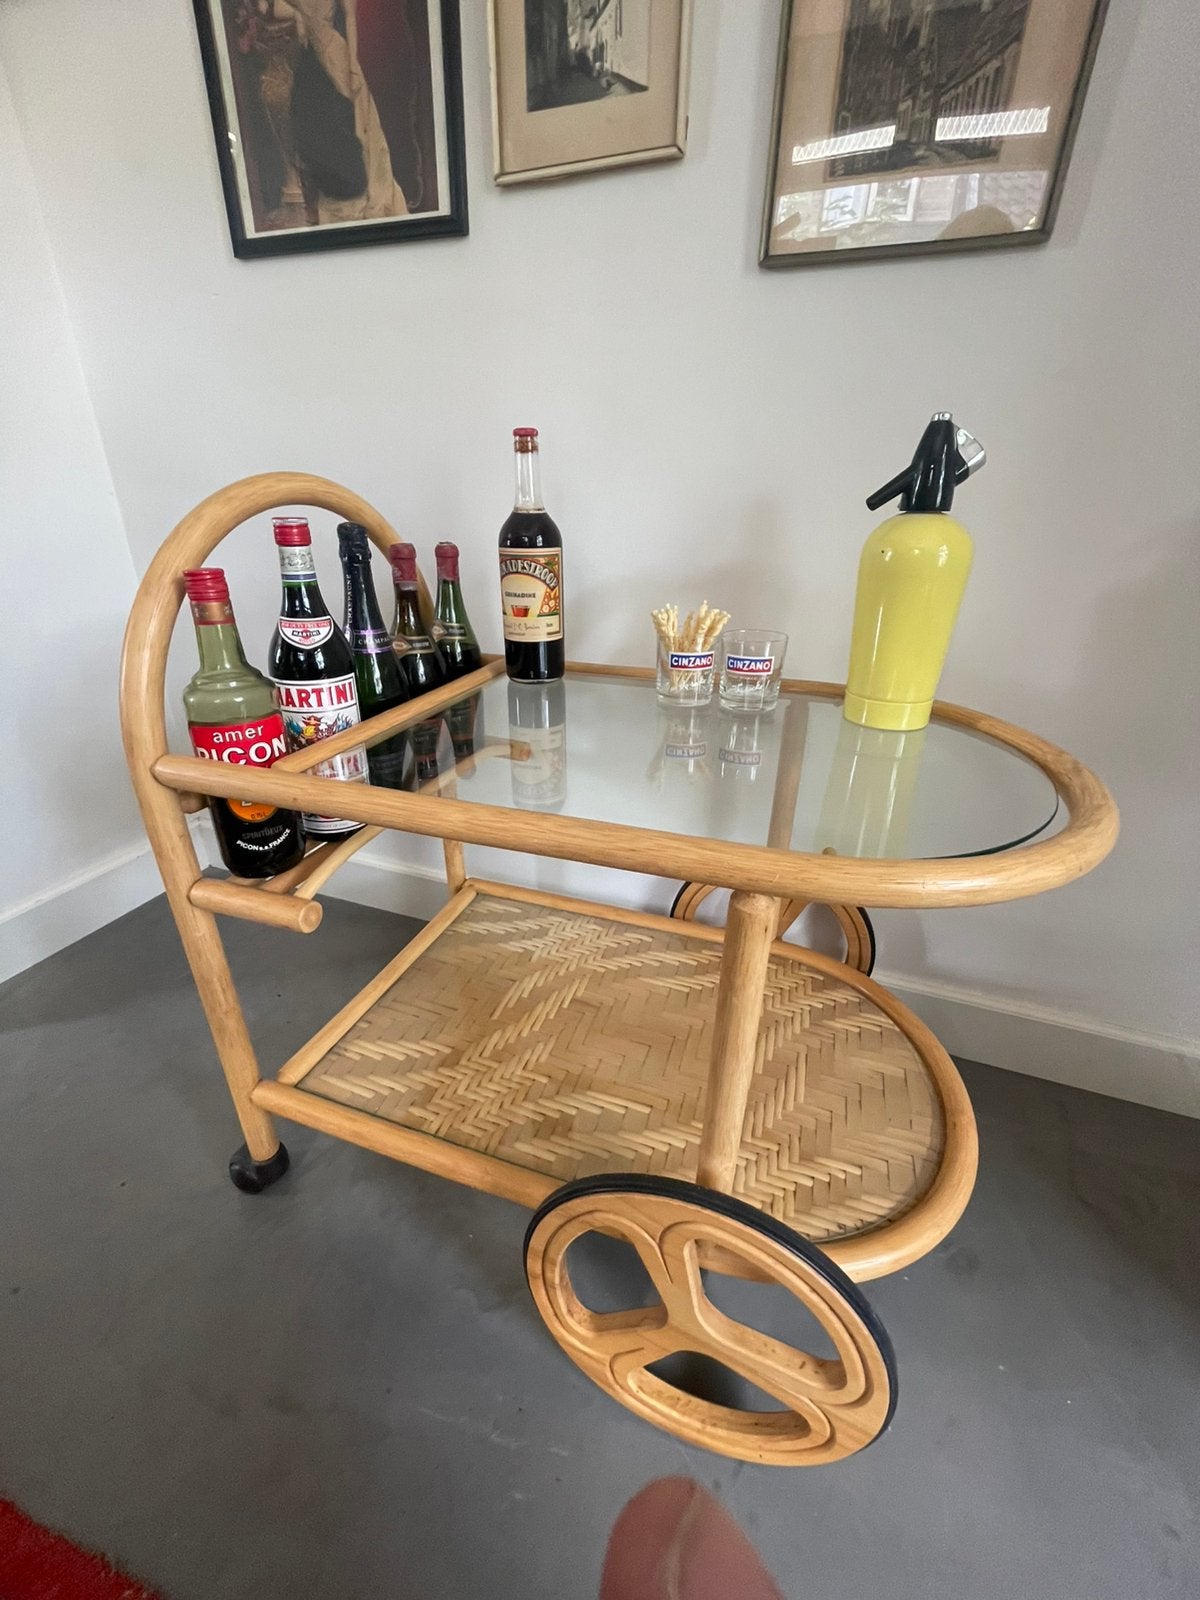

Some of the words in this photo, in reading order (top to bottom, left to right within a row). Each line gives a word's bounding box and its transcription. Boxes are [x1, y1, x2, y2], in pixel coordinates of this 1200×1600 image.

[672, 656, 713, 667] CINZANO
[728, 659, 770, 671] CINZANO
[213, 725, 264, 744] amer
[196, 734, 287, 765] PICON
[236, 840, 259, 851] PICON
[269, 828, 291, 849] FRANCE
